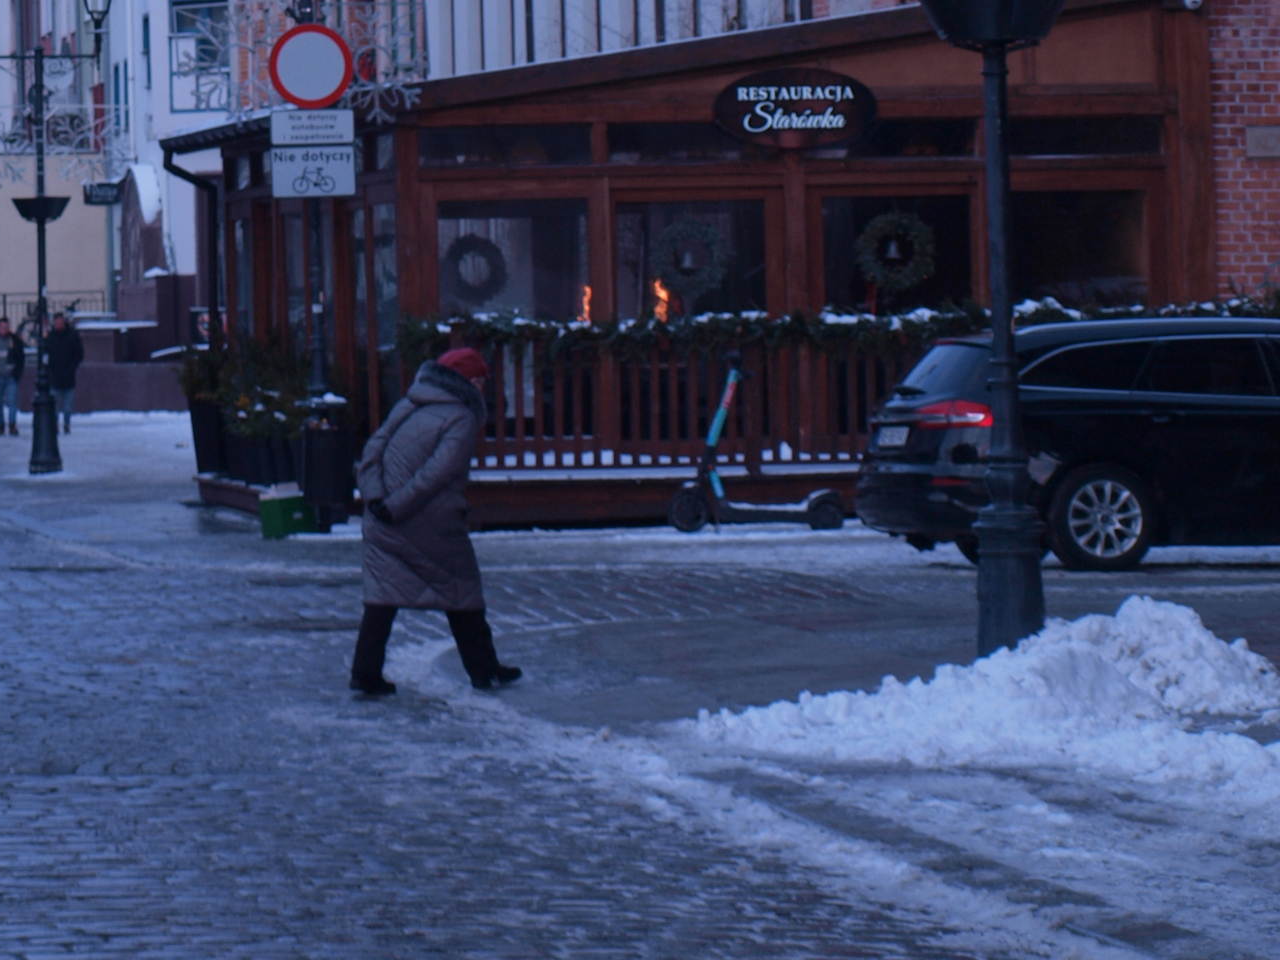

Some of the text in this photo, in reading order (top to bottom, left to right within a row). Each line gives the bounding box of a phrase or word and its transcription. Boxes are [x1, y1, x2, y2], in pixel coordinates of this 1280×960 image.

[737, 85, 854, 102] RESTAURACJA
[742, 101, 847, 133] Starówka
[273, 149, 352, 165] Nie dotyczy
